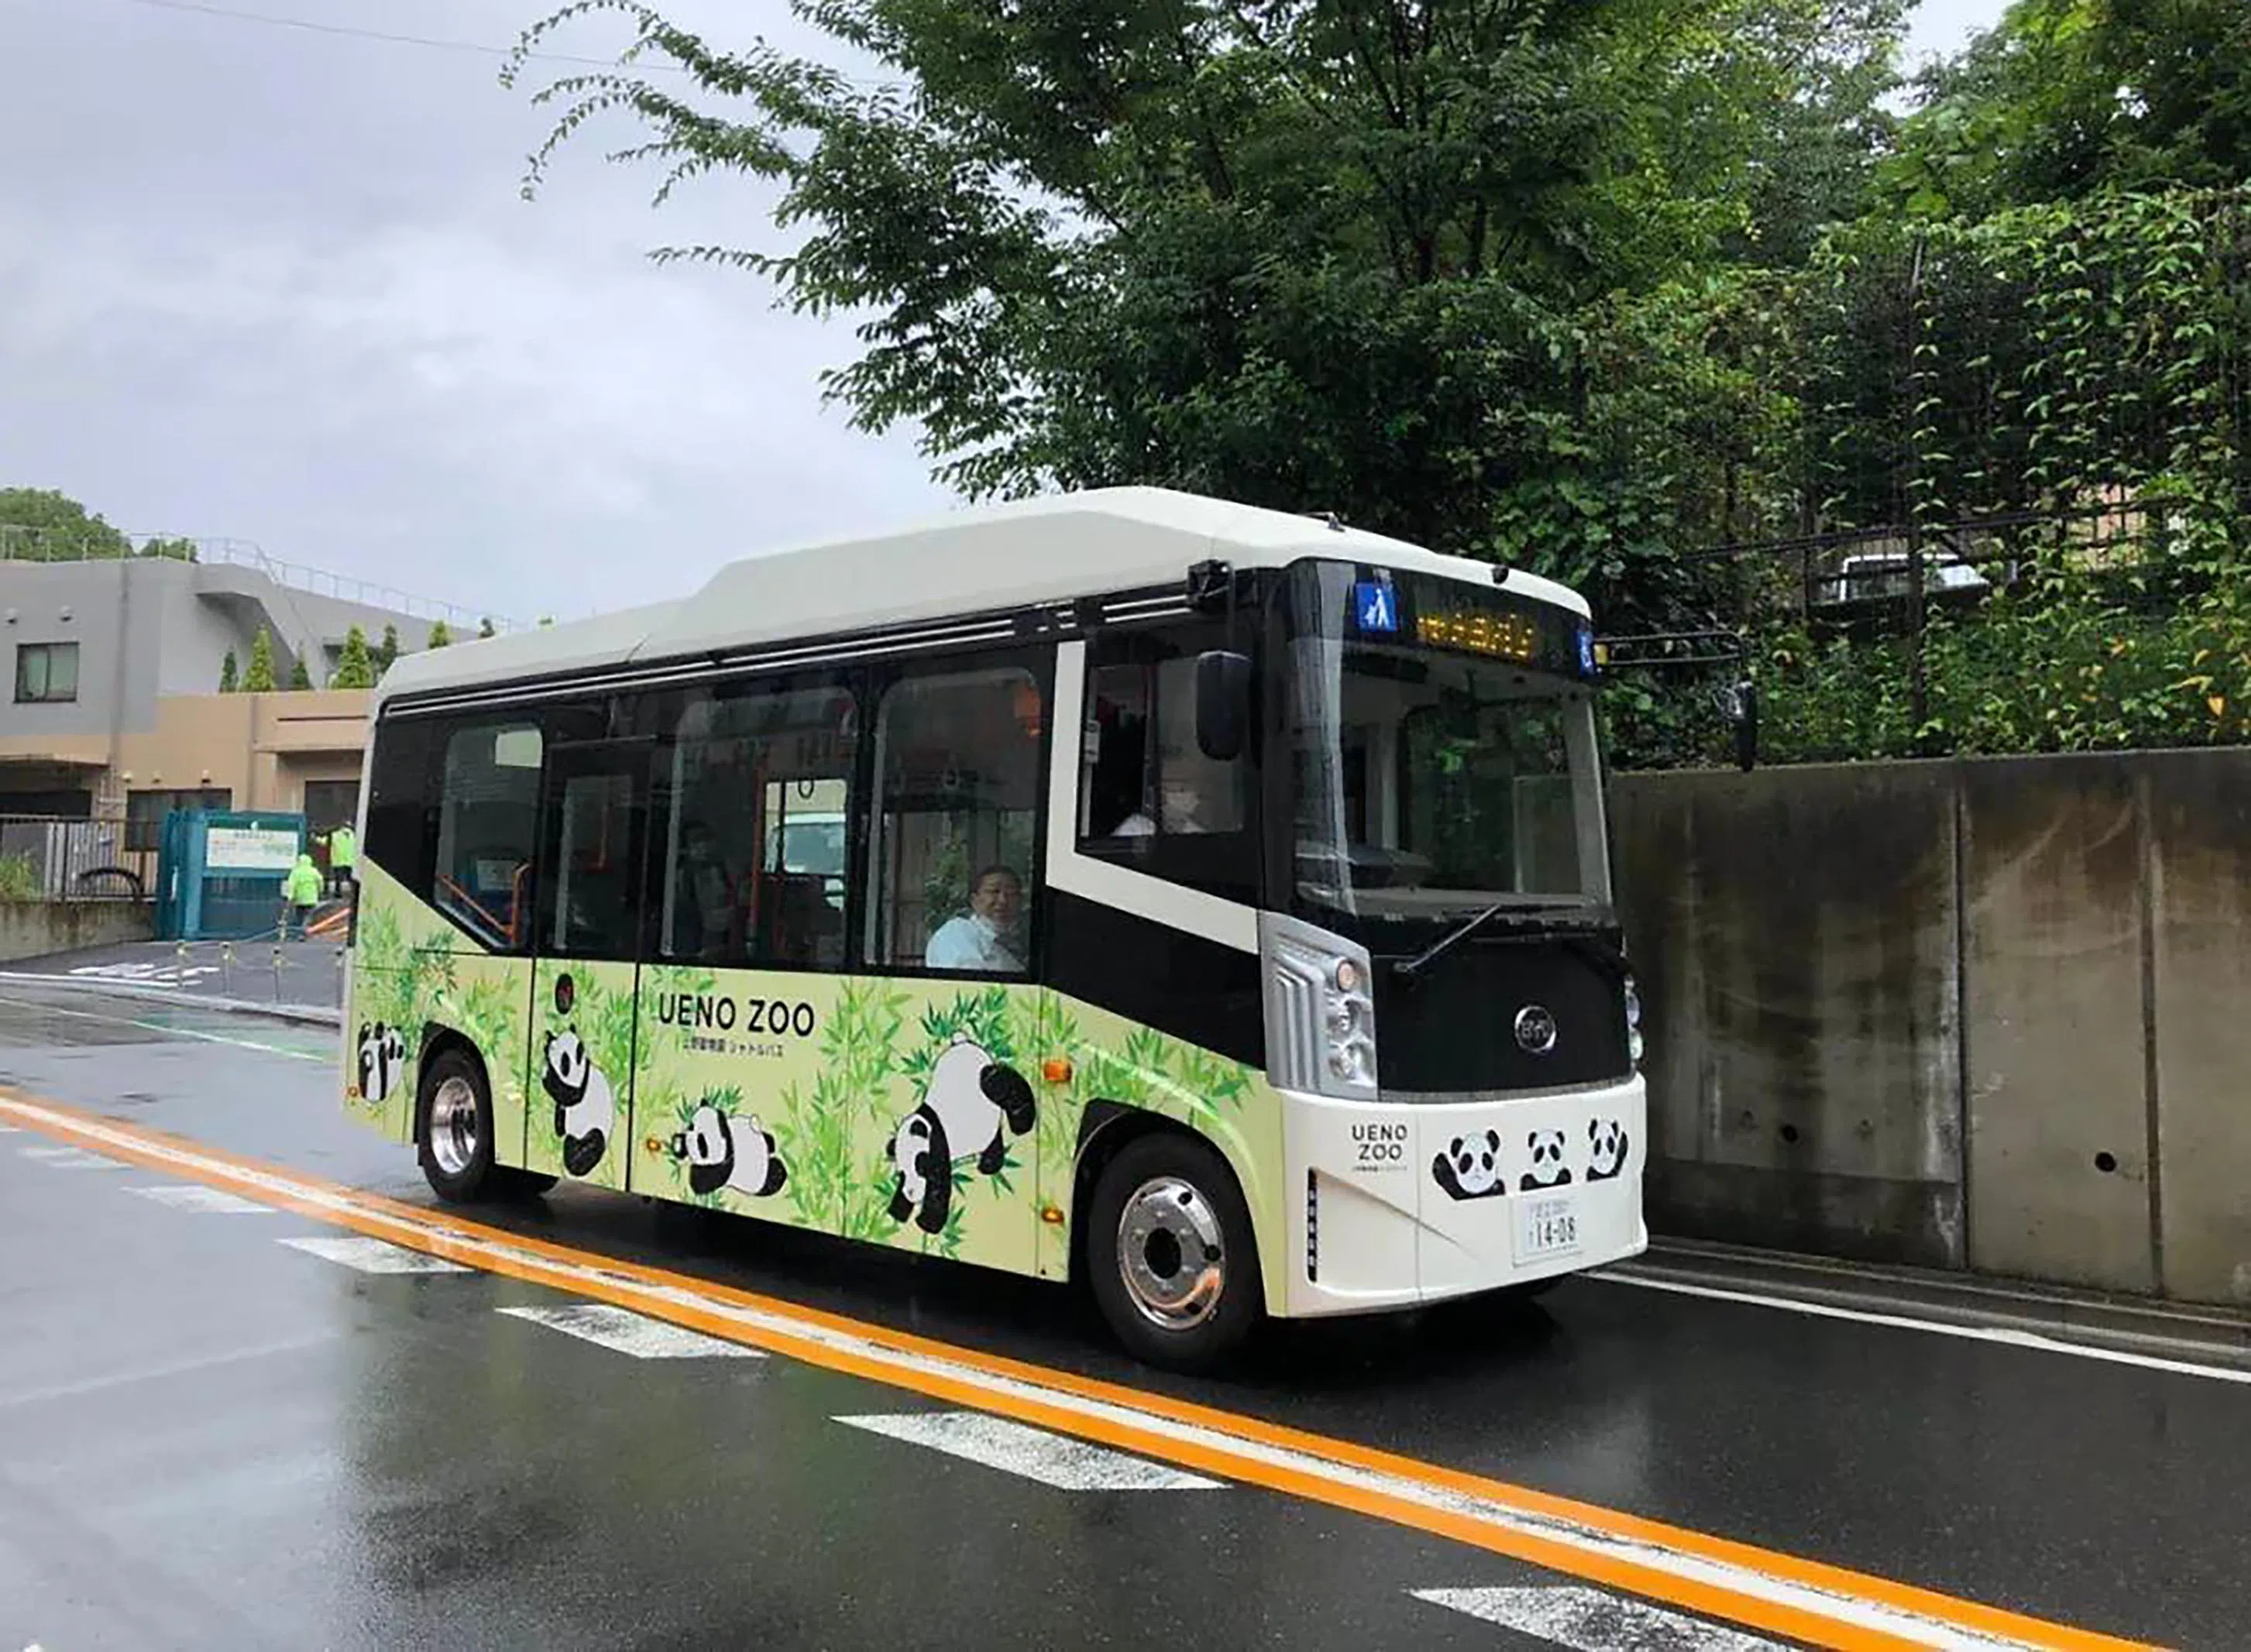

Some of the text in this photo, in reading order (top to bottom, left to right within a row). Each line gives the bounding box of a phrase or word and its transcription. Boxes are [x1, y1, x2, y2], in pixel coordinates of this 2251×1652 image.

[660, 992, 815, 1037] UENO ZOO
[1351, 1124, 1407, 1142] UENO
[1358, 1143, 1403, 1161] ZOO
